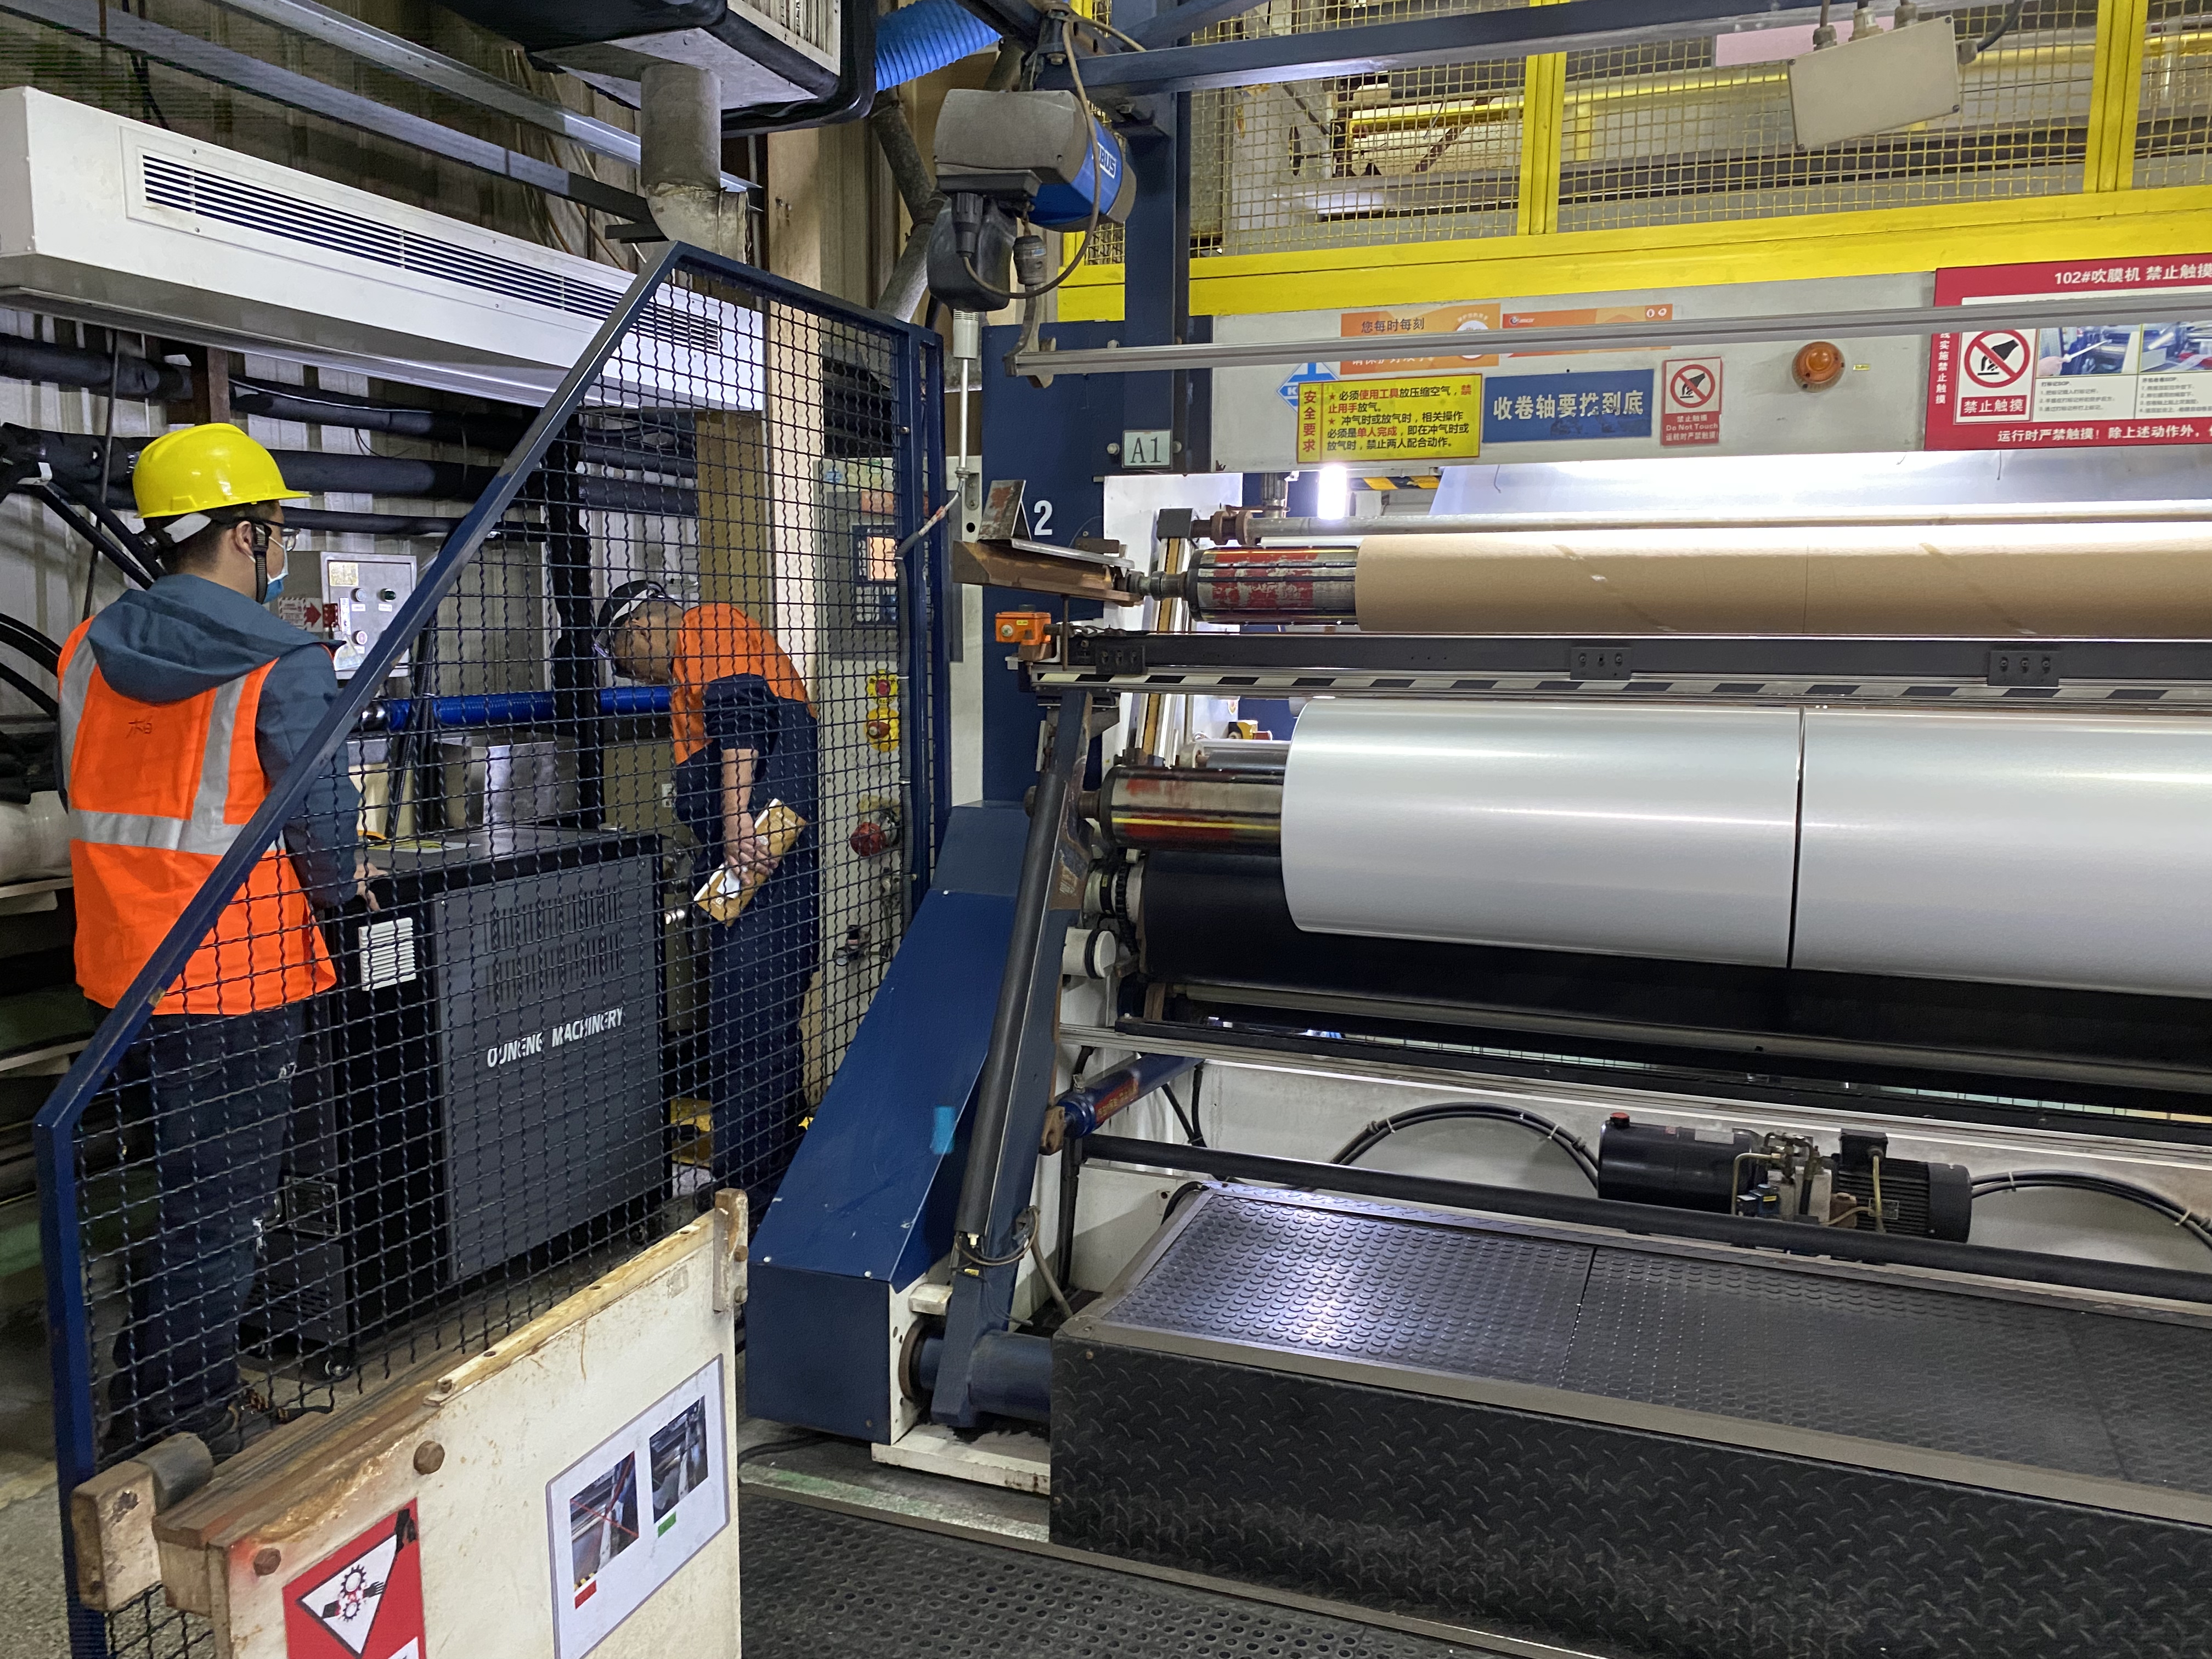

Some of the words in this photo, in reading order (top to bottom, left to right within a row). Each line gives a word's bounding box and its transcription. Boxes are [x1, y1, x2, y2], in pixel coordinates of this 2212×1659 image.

[1097, 144, 1116, 176] BUS
[2055, 267, 2141, 284] 102#吹膜机
[2146, 262, 2212, 281] 禁止触摸
[1361, 317, 1425, 333] 您每时每刻
[1328, 402, 1382, 414] 止用手放气。
[1963, 398, 2024, 414] 禁止触摸
[1302, 390, 1317, 453] 安全要求
[1130, 437, 1161, 463] A1
[1034, 500, 1053, 536] 2
[552, 1006, 623, 1047] MACHINERY
